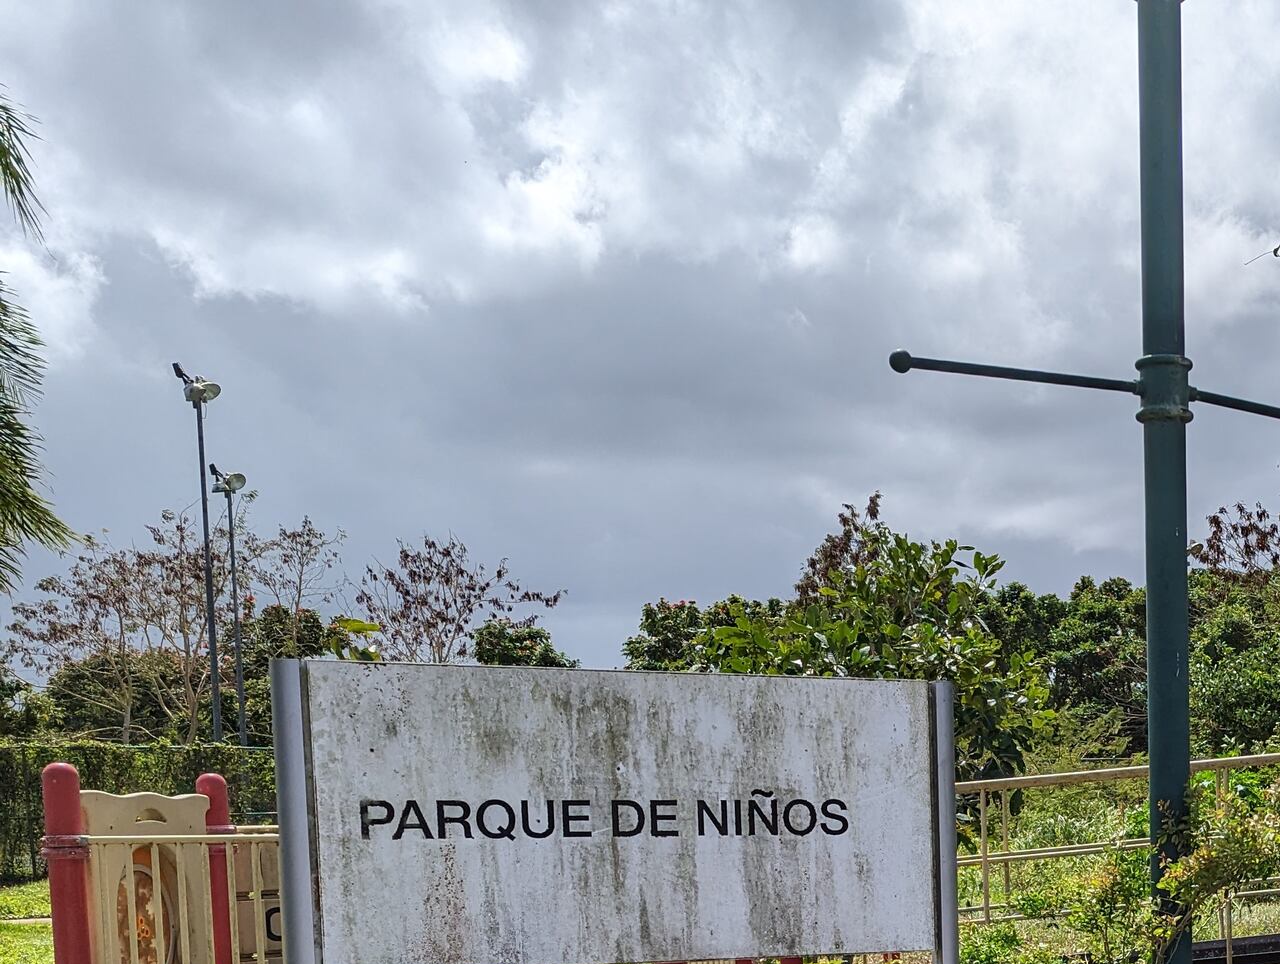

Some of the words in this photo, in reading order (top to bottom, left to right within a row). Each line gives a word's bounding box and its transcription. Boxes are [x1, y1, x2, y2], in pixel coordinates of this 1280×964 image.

[359, 799, 593, 841] PARQUE
[610, 799, 680, 838] DE
[696, 788, 849, 837] NIÑOS
